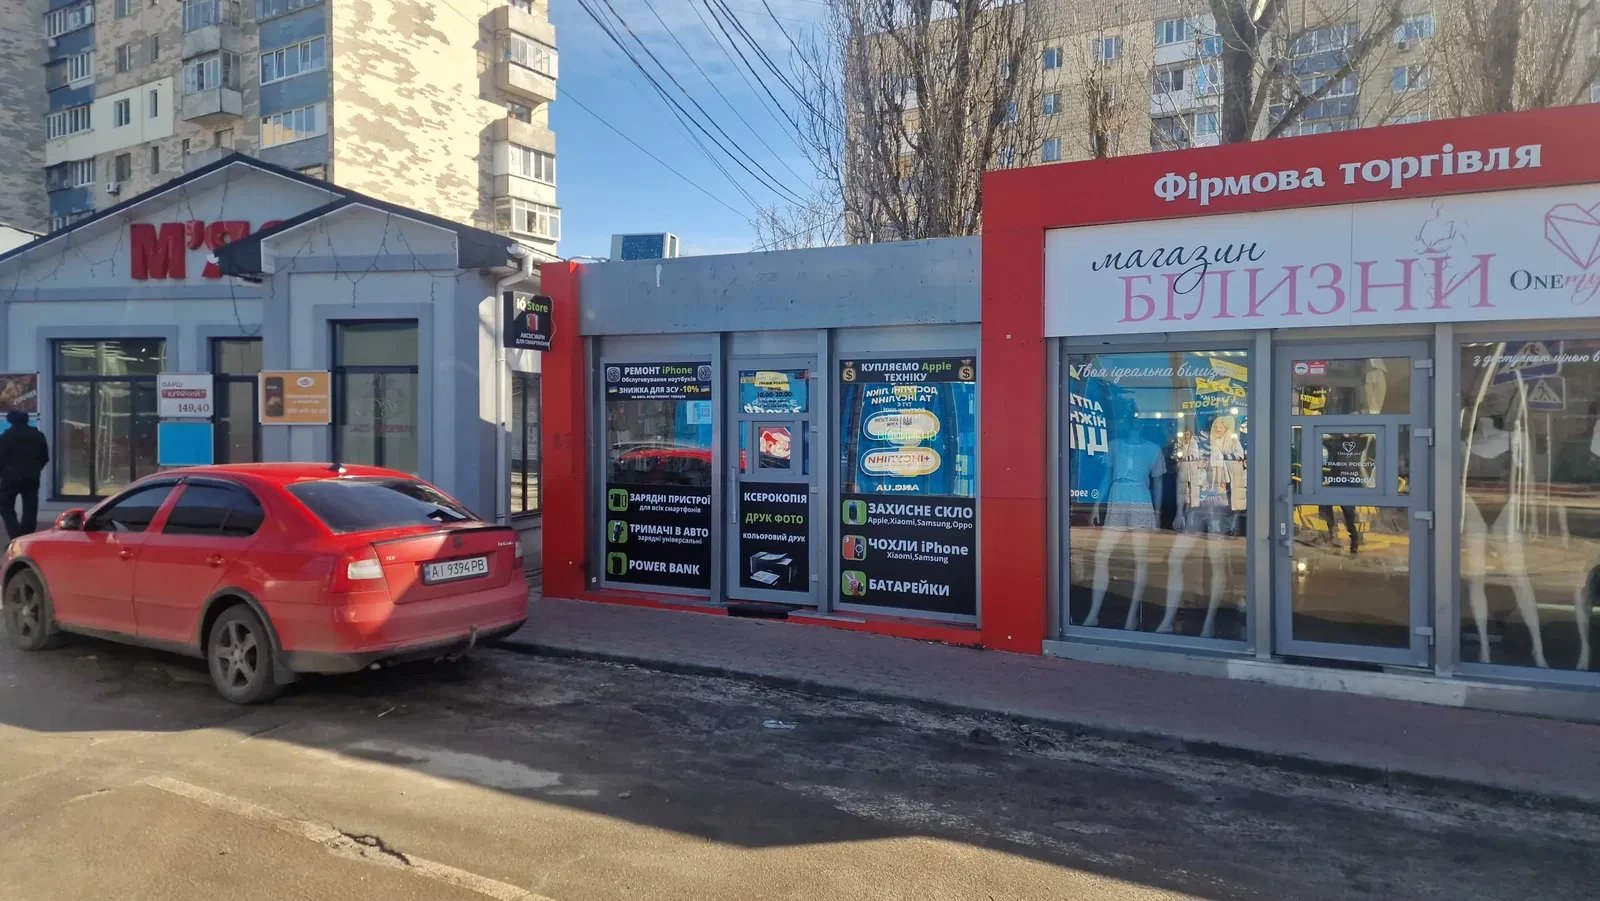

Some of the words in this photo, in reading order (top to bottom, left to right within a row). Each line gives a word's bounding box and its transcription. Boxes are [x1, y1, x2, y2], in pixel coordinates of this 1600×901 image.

[1154, 165, 1325, 205] Фірмова
[1339, 144, 1542, 188] торгівля
[1092, 241, 1265, 295] магазин
[527, 301, 548, 313] Store
[624, 366, 660, 375] РЕМОНТ
[662, 366, 693, 374] iPhone
[861, 362, 919, 372] КУПЛЯЄМО
[921, 362, 952, 373] Apple
[1077, 363, 1109, 379] Твоя
[1111, 366, 1173, 383] ідеальна
[884, 373, 927, 382] ТЕХНІКУ
[619, 386, 649, 394] ЗНИЖКА
[650, 386, 664, 395] ДЛЯ
[680, 385, 699, 393] -10%
[178, 403, 210, 414] 149,40
[1323, 476, 1376, 484] 10:00-20:00
[629, 493, 666, 504] ЗАРЯДНІ
[668, 495, 711, 505] ПРИСТРОЇ
[744, 492, 807, 504] КСЕРОКОПІЯ
[665, 506, 701, 514] смартфонів
[868, 502, 932, 517] ЗАХИСНЕ
[934, 506, 973, 519] СКЛО
[745, 513, 772, 524] ДРУК
[774, 514, 804, 524] ФОТО
[867, 516, 973, 530] Apple,Xiaomi,Samsung,Oppo
[629, 524, 672, 535] ТРИМАЧІ
[675, 527, 681, 535] В
[683, 527, 709, 537] АВТО
[637, 535, 661, 543] зарядні
[662, 536, 702, 545] універсальні
[742, 532, 787, 541] КОЛЬОРОВИЙ
[788, 535, 806, 543] ДРУК
[868, 537, 918, 552] ЧОХЛИ
[921, 541, 969, 555] iPhone
[887, 552, 949, 564] Xiaomi,Samsung
[448, 562, 470, 577] 9394
[629, 560, 666, 572] POWER
[669, 563, 700, 575] BANK
[869, 578, 950, 597] БАТАРЕЙКИ
